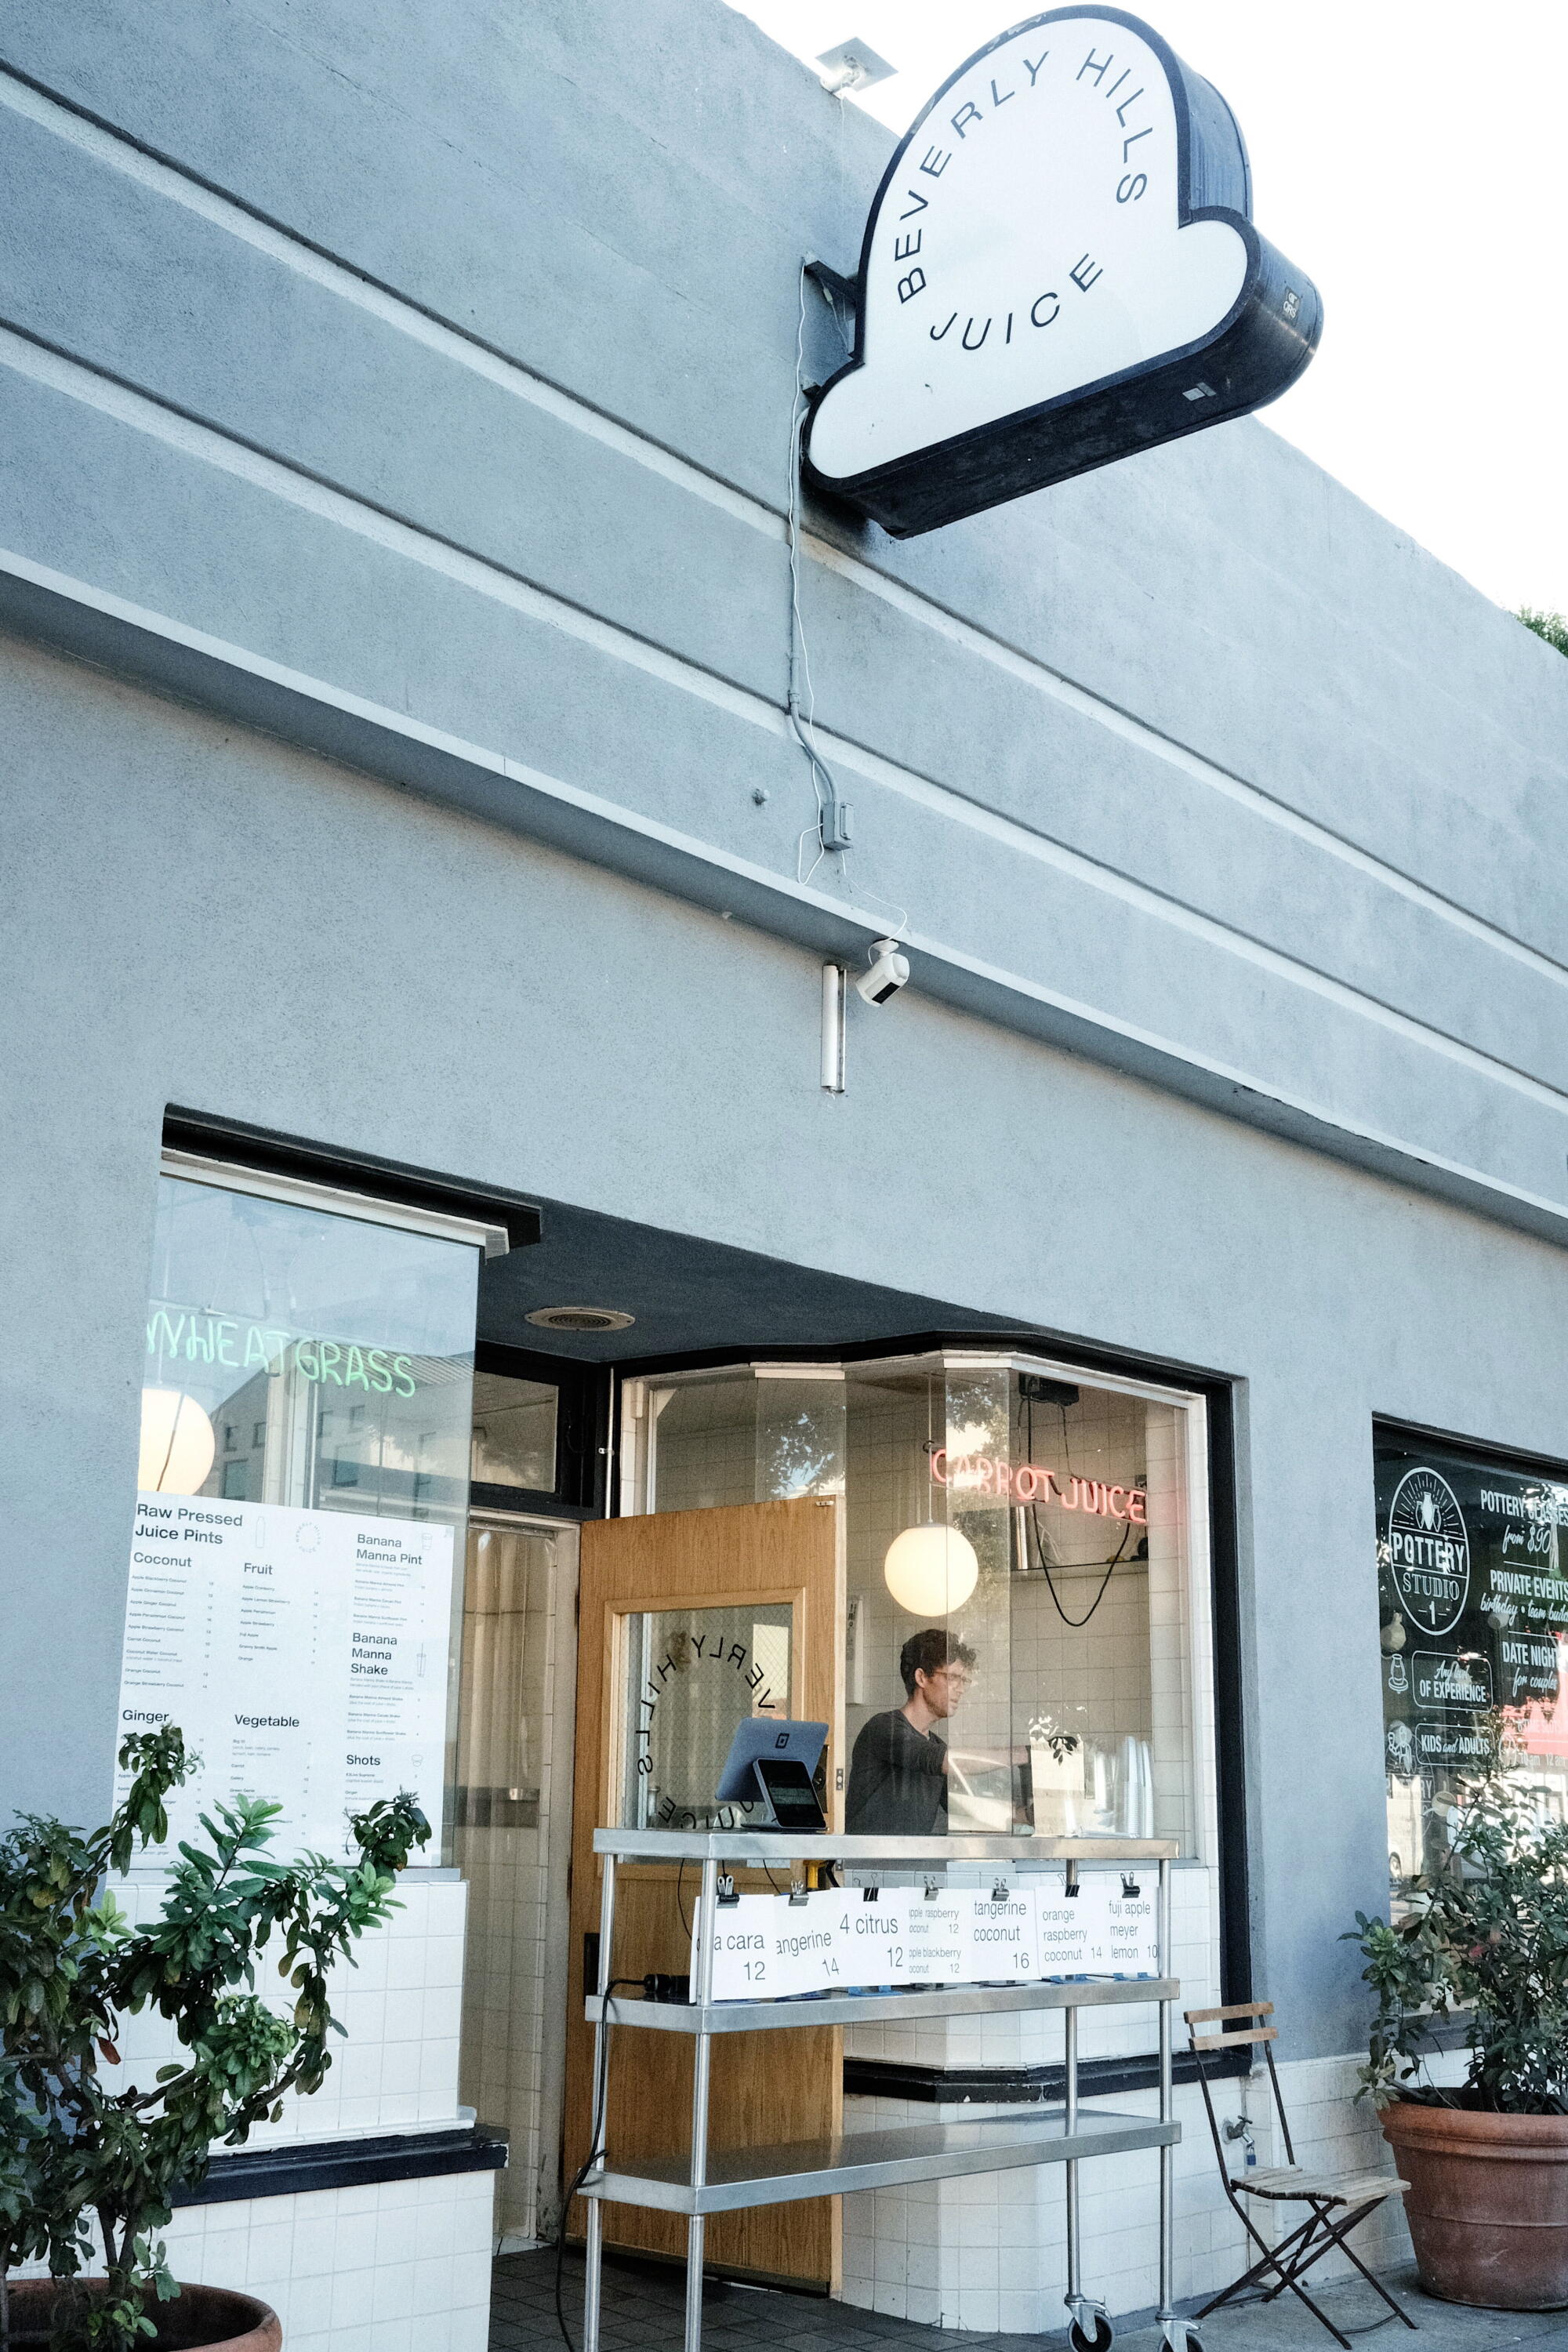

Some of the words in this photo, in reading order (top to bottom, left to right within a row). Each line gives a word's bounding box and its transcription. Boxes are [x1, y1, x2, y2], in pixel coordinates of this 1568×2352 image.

[895, 50, 1050, 304] BEVERLY
[1076, 48, 1152, 204] HILLS
[929, 253, 1103, 350] JUICE
[147, 1310, 291, 1375] WHEAT
[295, 1338, 416, 1398] GRASS
[1061, 1477, 1147, 1523] JUICE
[1481, 1490, 1524, 1518] POTTERY
[137, 1504, 172, 1519] Raw
[178, 1508, 243, 1526] Pressed
[136, 1524, 179, 1540] Juice
[184, 1529, 223, 1544] Pints
[358, 1534, 401, 1548] Banana
[1527, 1523, 1551, 1555] $90
[133, 1552, 191, 1567] Coconut
[357, 1549, 396, 1562] Manna
[401, 1554, 422, 1565] Pint
[1392, 1532, 1465, 1572] POTTERY
[244, 1563, 273, 1575] Fruit
[1403, 1572, 1459, 1600] STUDIO
[1490, 1570, 1532, 1596] PRIVATE
[1534, 1576, 1568, 1602] EVENTS
[1480, 1592, 1518, 1626] birthday
[1528, 1599, 1546, 1619] team
[353, 1632, 397, 1645] Banana
[352, 1648, 391, 1660] Manna
[1502, 1642, 1529, 1665] DATE
[351, 1663, 388, 1675] Shake
[1512, 1667, 1527, 1697] for
[1420, 1679, 1431, 1697] OF
[1434, 1680, 1486, 1703] EXPERIENCE
[122, 1709, 169, 1724] Ginger
[234, 1714, 299, 1728] Vegetable
[1421, 1734, 1442, 1753] KIDS
[1443, 1738, 1458, 1753] and
[1459, 1737, 1490, 1755] ADULTS
[347, 1755, 381, 1766] Shots
[909, 1907, 923, 1918] pple
[925, 1908, 960, 1920] raspberry
[974, 1900, 1026, 1919] tangerine
[1043, 1910, 1075, 1923] orange
[1109, 1900, 1121, 1917] fuji
[1125, 1900, 1151, 1917] apple
[840, 1914, 850, 1934] 4
[856, 1914, 898, 1934] citrus
[909, 1924, 929, 1933] oconut
[949, 1924, 959, 1934] 12
[1110, 1925, 1138, 1940] meyer
[727, 1934, 765, 1950] cara
[974, 1926, 1020, 1941] coconut
[1044, 1928, 1087, 1943] raspberry
[775, 1930, 832, 1957] angerine
[1111, 1945, 1138, 1959] lemon
[1148, 1945, 1158, 1958] 10
[887, 1947, 903, 1967] 12
[923, 1947, 961, 1959] blackberry
[1013, 1952, 1029, 1969] 16
[1044, 1947, 1082, 1962] coconut
[1091, 1946, 1102, 1959] 14
[744, 1962, 766, 1980] 12
[822, 1958, 840, 1976] 14
[909, 1964, 929, 1973] oconut
[949, 1963, 960, 1973] 12
